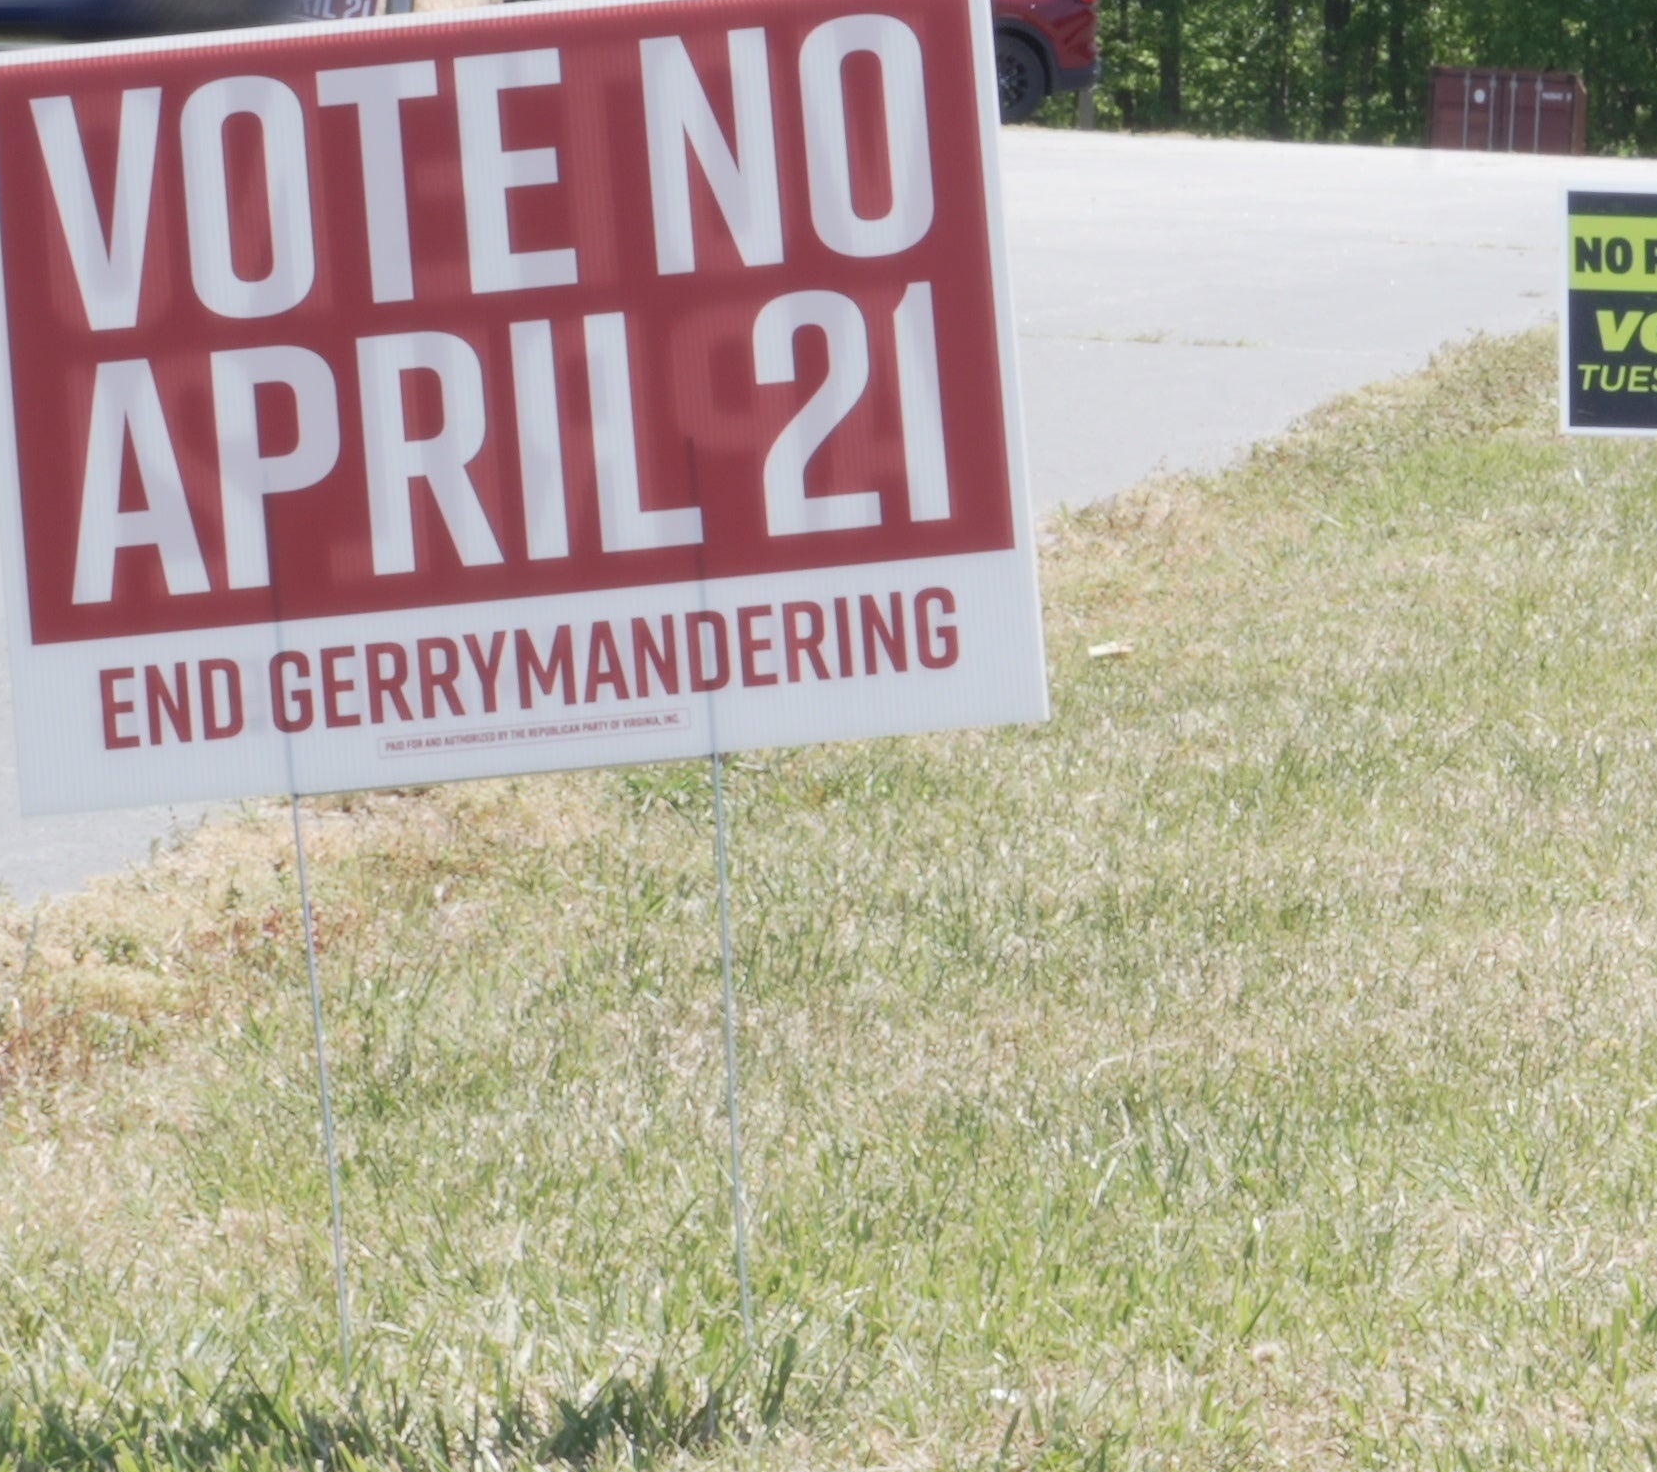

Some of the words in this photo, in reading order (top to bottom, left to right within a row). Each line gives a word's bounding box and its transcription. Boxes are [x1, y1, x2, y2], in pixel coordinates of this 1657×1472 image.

[29, 46, 578, 331] VOTE
[638, 13, 935, 276] NO
[1574, 236, 1633, 275] NO
[71, 311, 703, 605] APRIL
[752, 281, 950, 536] 21
[98, 656, 244, 751] END
[269, 587, 960, 732] GERRYMANDERING
[407, 739, 423, 750] FOR
[425, 738, 442, 749] AND
[444, 733, 495, 747] AUTHORIZED
[497, 732, 508, 742] BY
[510, 730, 525, 740] THE
[528, 724, 580, 739] REPUBLICAN
[582, 722, 608, 733] PARTY
[610, 720, 621, 730] OF
